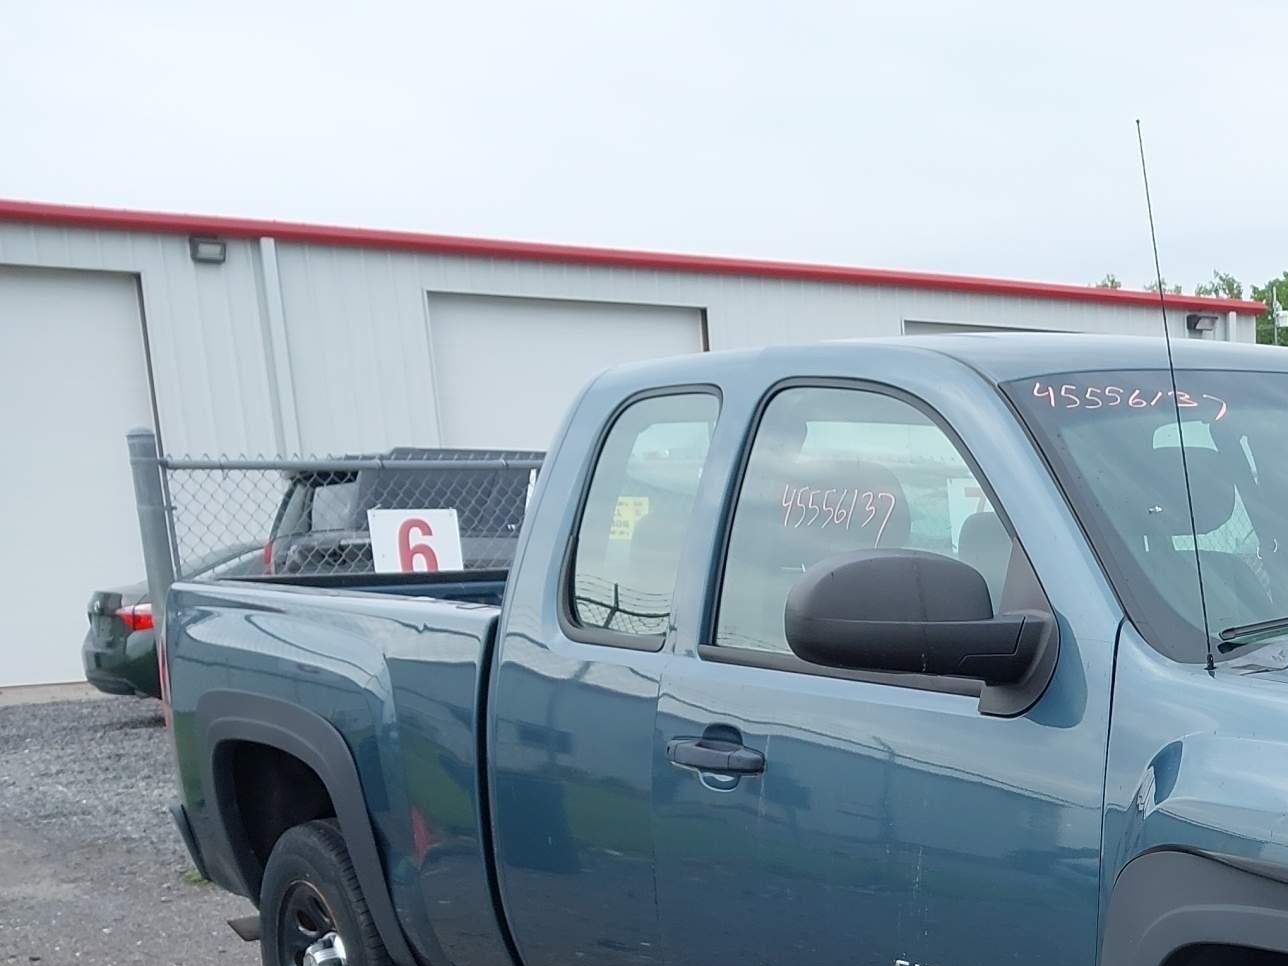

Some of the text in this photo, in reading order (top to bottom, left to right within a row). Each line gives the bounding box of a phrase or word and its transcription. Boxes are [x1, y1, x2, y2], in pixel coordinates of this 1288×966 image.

[1032, 382, 1227, 421] 45556137
[782, 484, 896, 549] 45556137
[398, 517, 439, 574] 6
